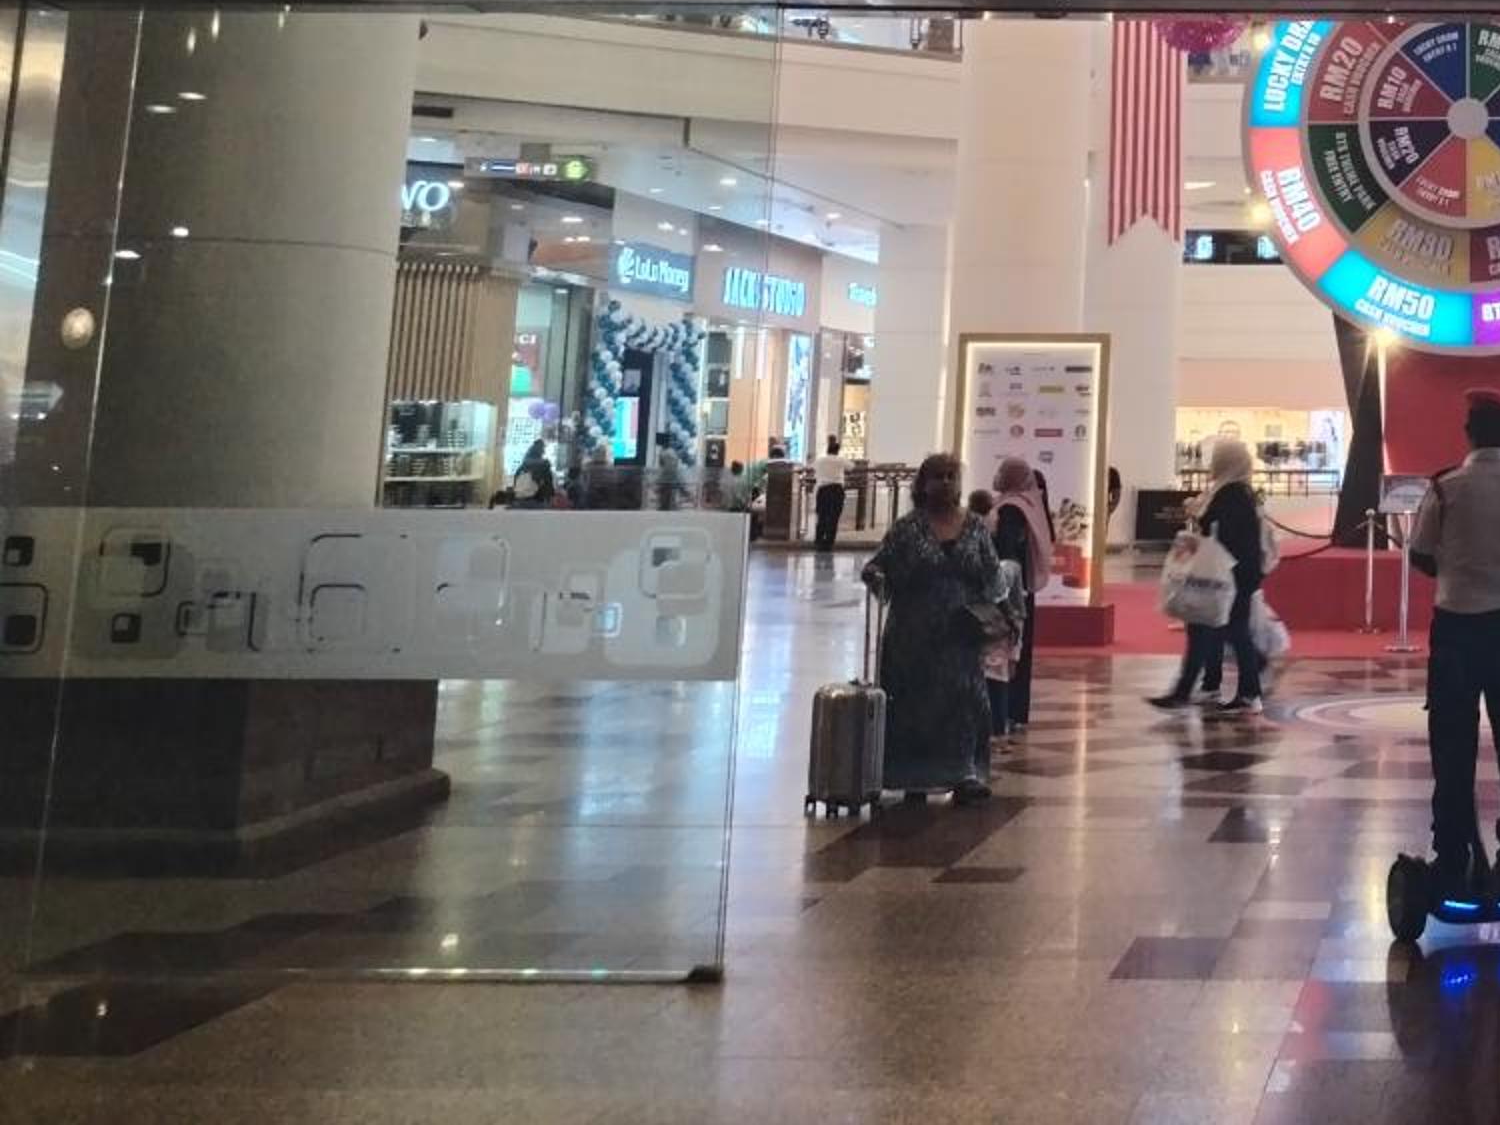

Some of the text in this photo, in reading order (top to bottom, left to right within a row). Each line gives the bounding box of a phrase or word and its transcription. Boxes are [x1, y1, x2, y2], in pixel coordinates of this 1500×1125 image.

[1264, 50, 1292, 111] LUCKY
[1320, 36, 1363, 102] RM20
[1377, 66, 1407, 110] RM10
[1394, 126, 1420, 164] RM20
[1278, 165, 1321, 232] RM40
[1366, 274, 1435, 319] RM50
